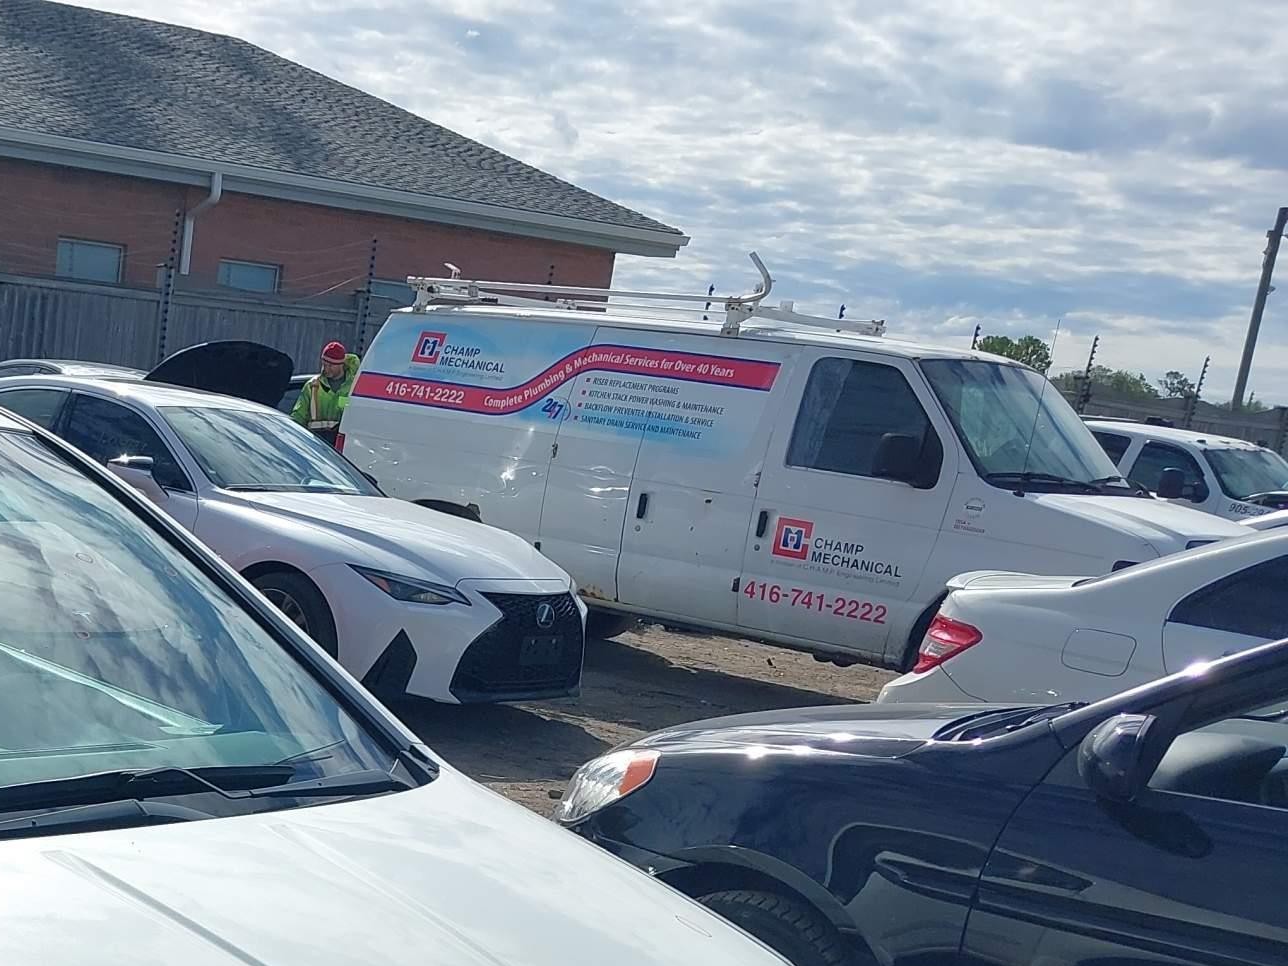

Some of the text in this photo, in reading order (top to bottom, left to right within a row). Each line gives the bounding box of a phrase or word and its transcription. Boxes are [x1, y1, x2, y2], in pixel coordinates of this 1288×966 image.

[444, 344, 481, 358] CHAMP
[439, 356, 505, 373] MECHANICAL
[386, 381, 465, 404] 416-741-2222
[484, 352, 735, 409] Complete Plumbing & Mechanical Services for Over 40 Years
[593, 377, 680, 395] RISER REPLACEMENT PROGRAMS
[584, 402, 613, 413] BACKFLOW
[613, 406, 646, 417] PREVENTER
[645, 409, 685, 422] INSTALLATION
[689, 416, 714, 427] SERVICE
[588, 390, 612, 400] KITCHEN
[612, 393, 629, 402] STACK
[628, 395, 649, 405] POWER
[649, 398, 676, 408] WASHING
[682, 402, 725, 415] MAINTENANCE
[581, 415, 703, 439] SANITARY DRAIN SERVICE AND MAINTENANCE
[814, 537, 864, 555] CHAMP
[810, 551, 902, 578] MECHANICAL
[743, 580, 888, 625] 416-741-2222
